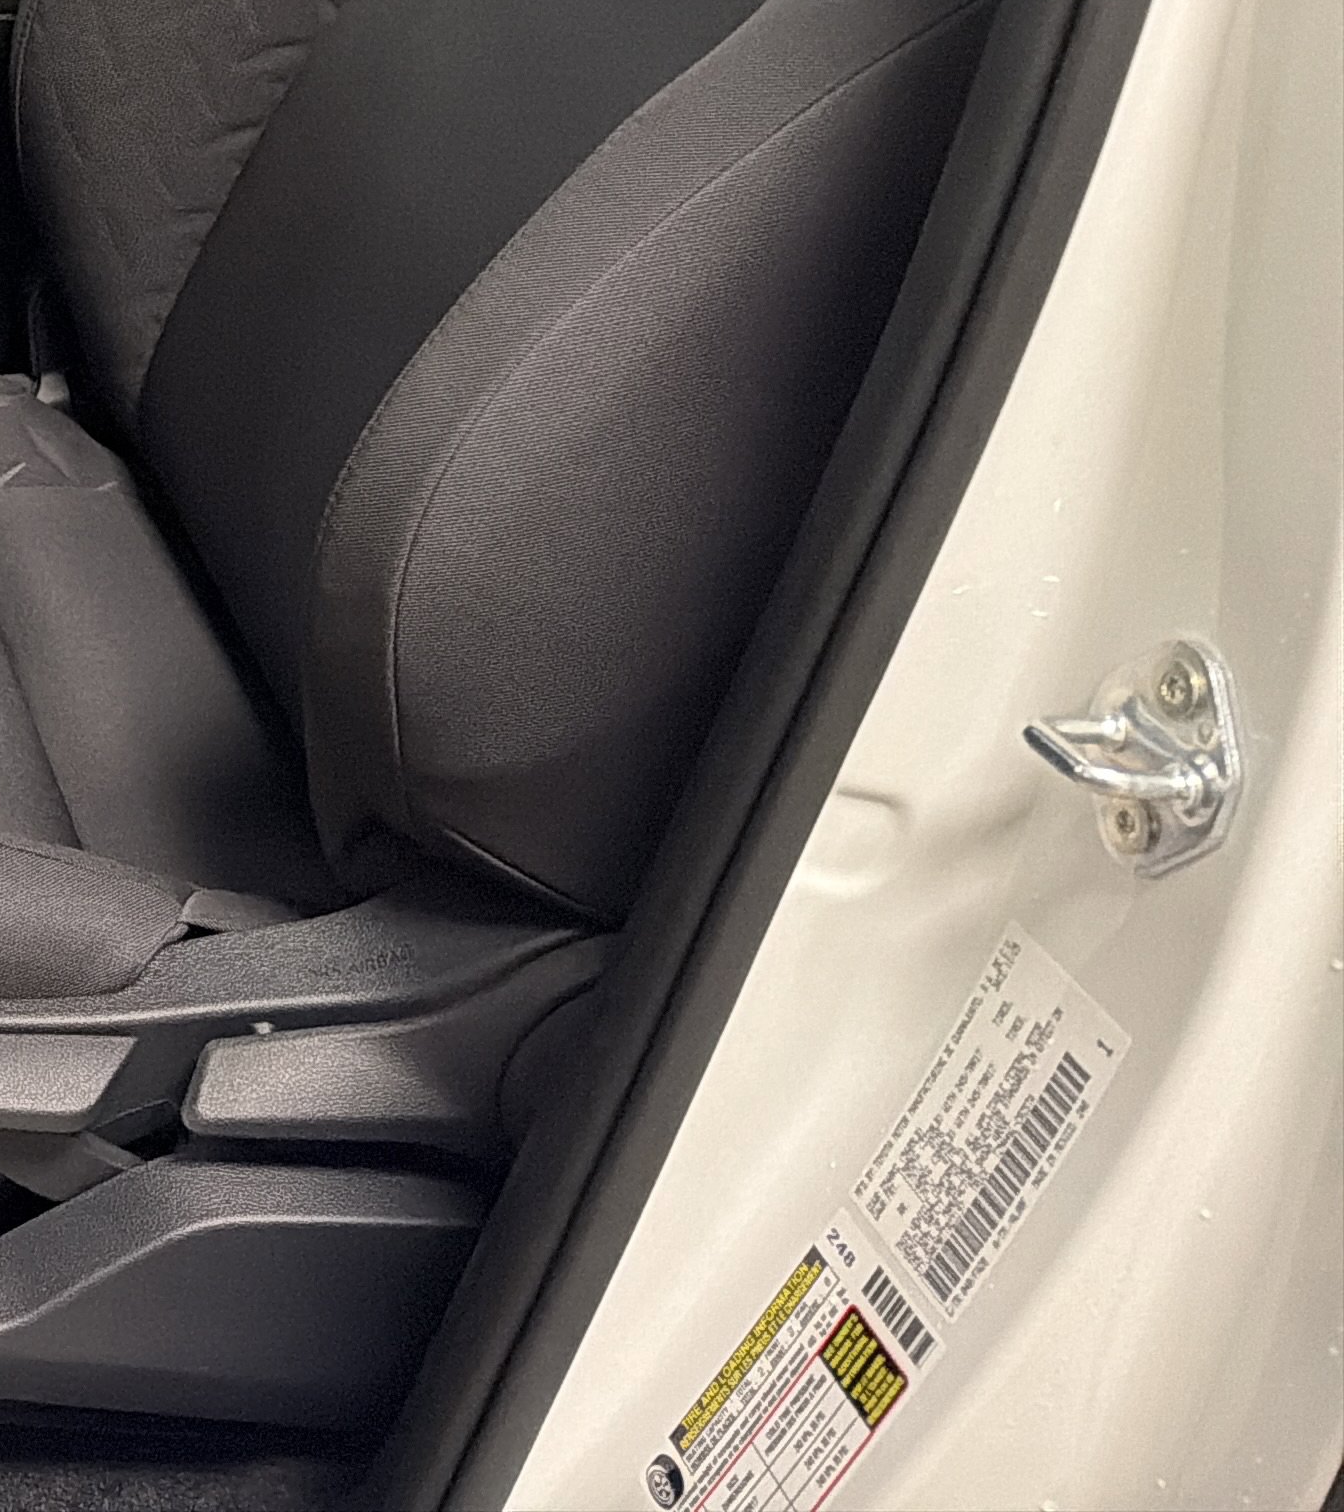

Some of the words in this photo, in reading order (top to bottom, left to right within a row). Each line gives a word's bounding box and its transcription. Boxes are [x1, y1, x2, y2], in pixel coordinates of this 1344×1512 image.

[1095, 1036, 1114, 1058] 1
[825, 1227, 857, 1269] 248
[680, 1403, 702, 1431] TIRE
[698, 1379, 720, 1408] AND
[716, 1333, 756, 1385] LOADING
[750, 1261, 810, 1338] INFORMATION
